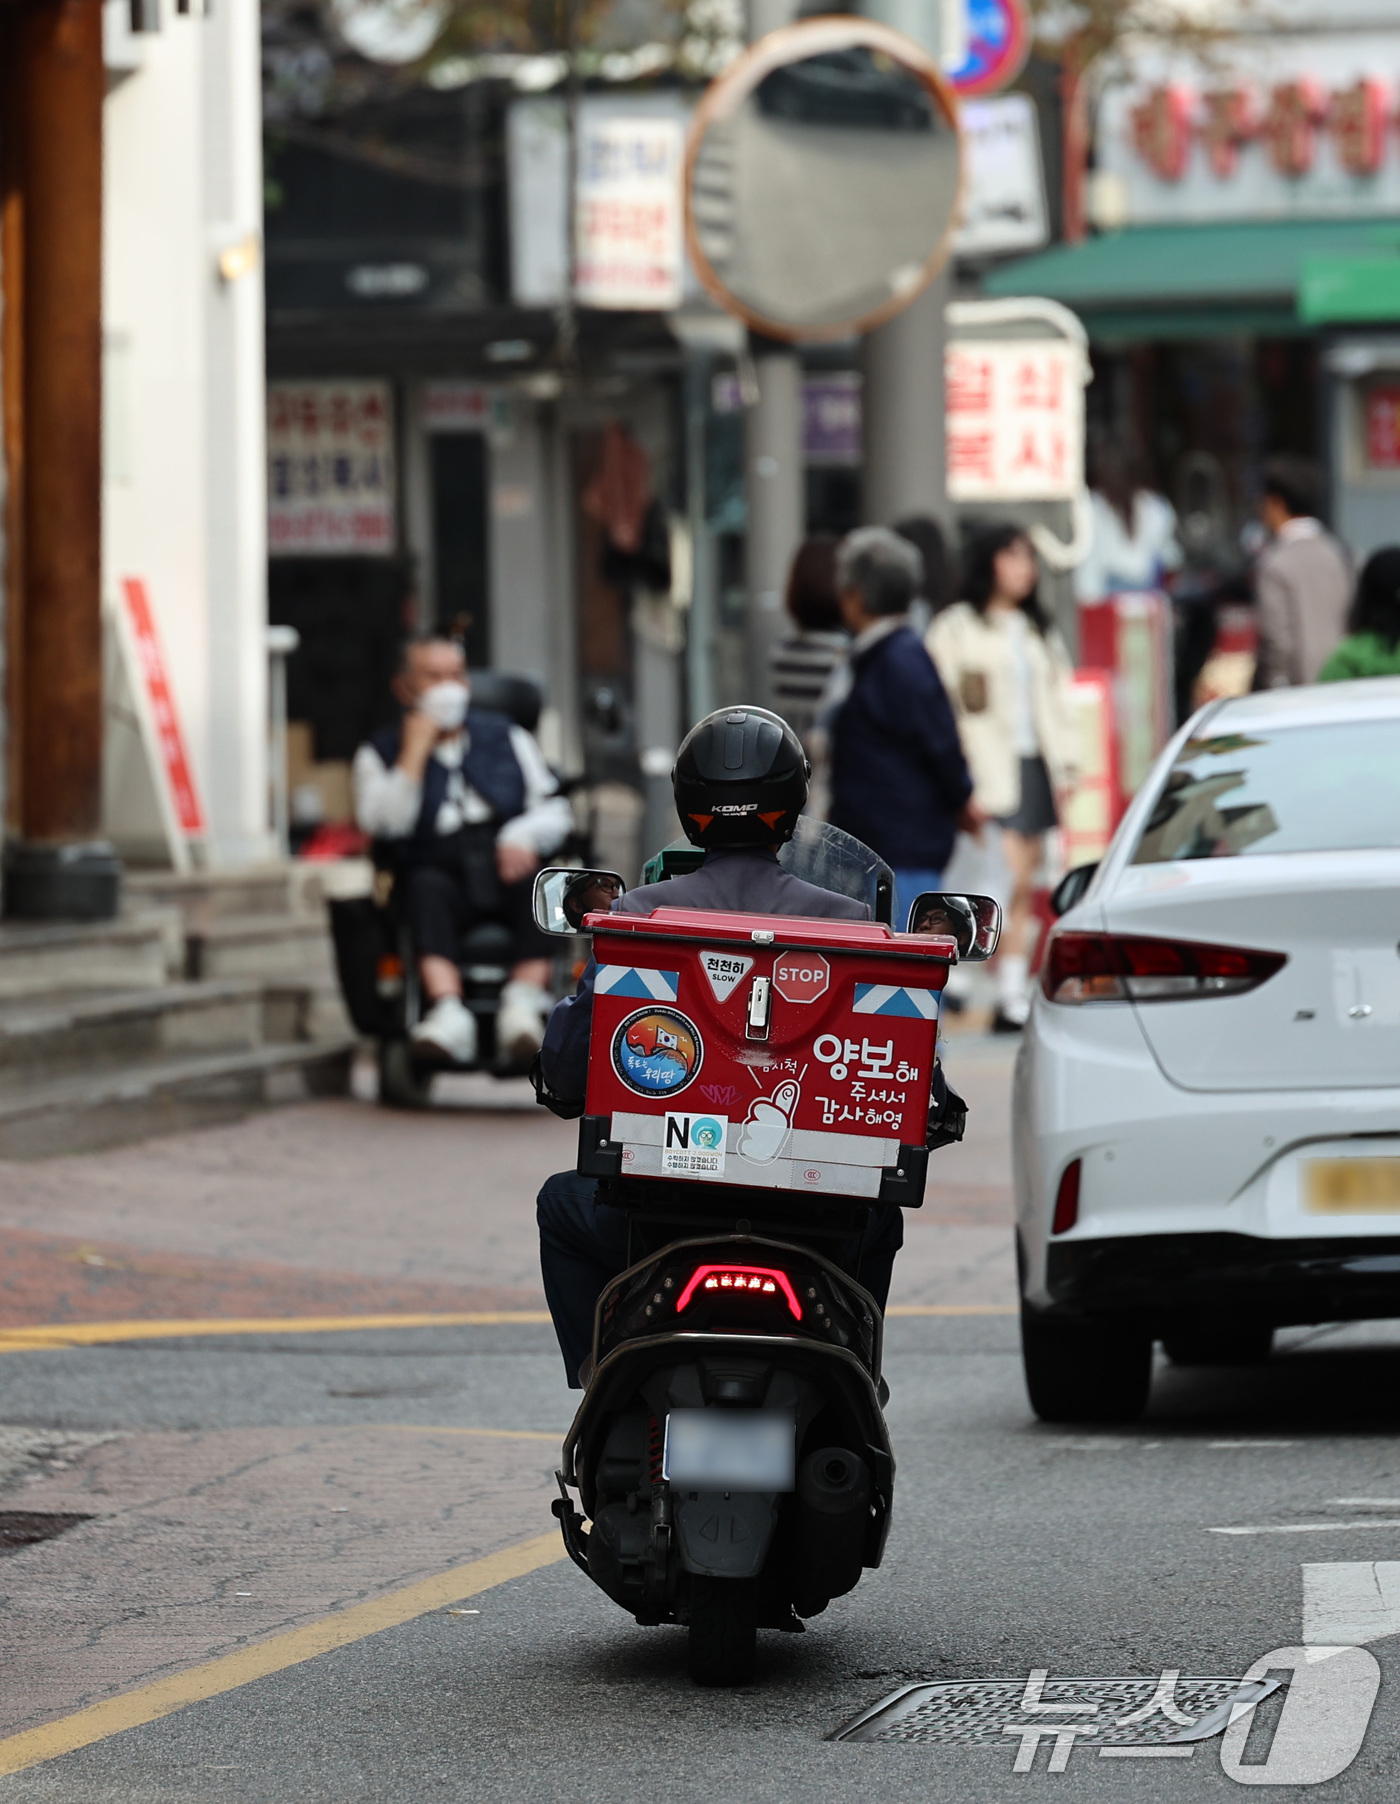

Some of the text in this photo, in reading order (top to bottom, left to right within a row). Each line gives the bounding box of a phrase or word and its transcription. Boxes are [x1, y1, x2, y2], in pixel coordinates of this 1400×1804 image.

[711, 803, 758, 813] KOMO
[707, 958, 745, 974] 천천히
[712, 973, 736, 982] SLOW
[778, 967, 824, 983] STOP
[628, 1056, 648, 1070] 독도는
[641, 1067, 677, 1084] 우리땅
[850, 1081, 906, 1104] 주셔서
[814, 1096, 903, 1131] 감사해영
